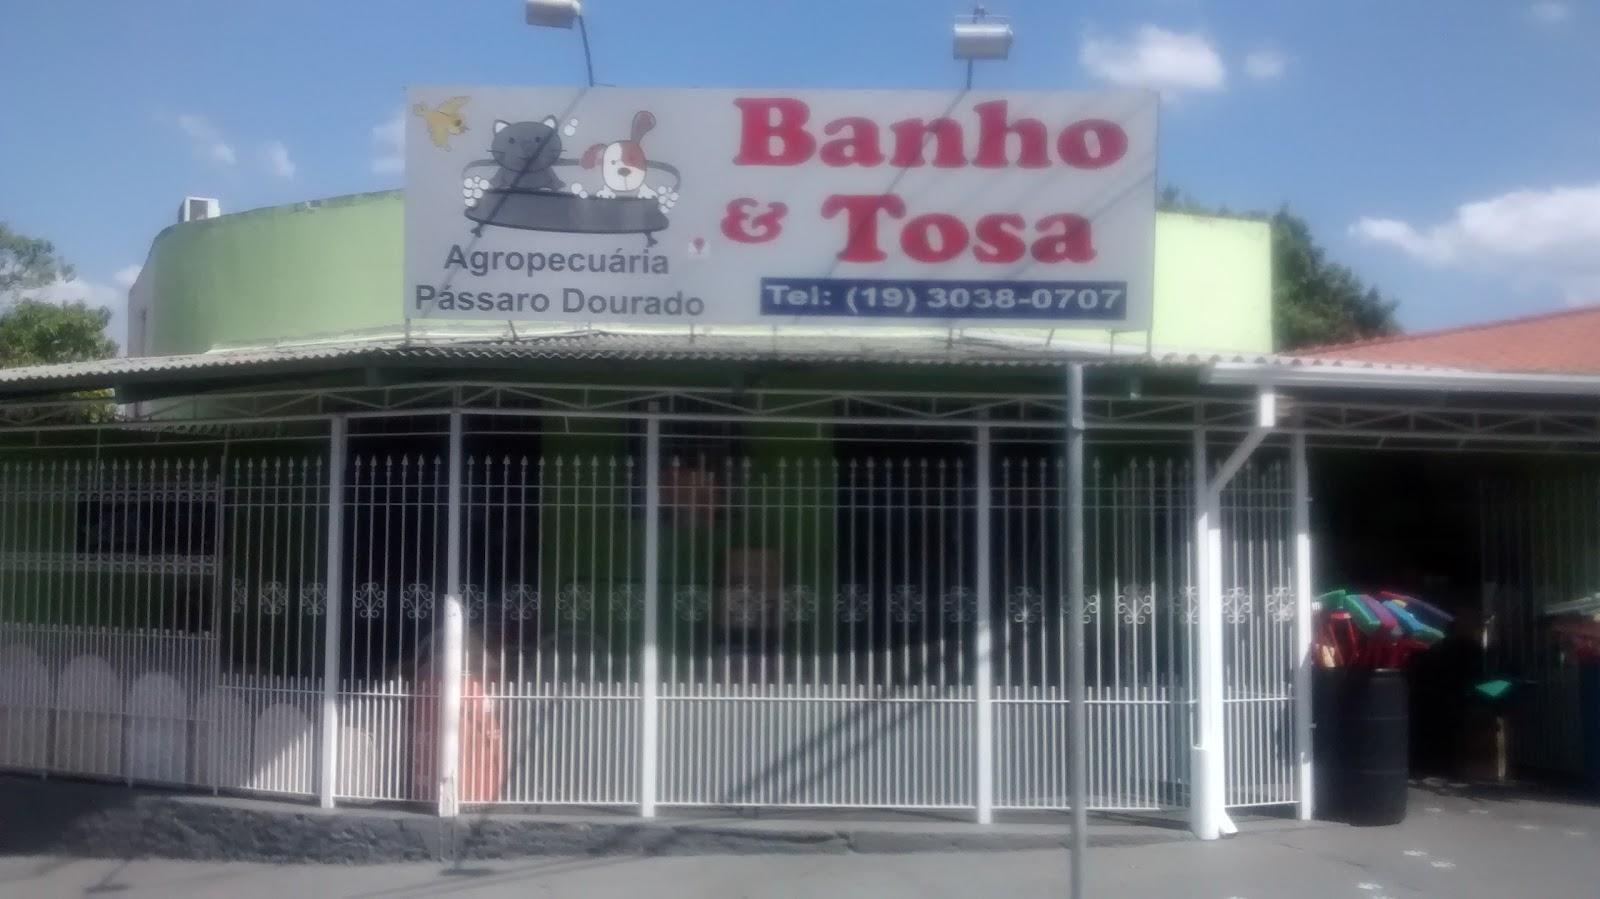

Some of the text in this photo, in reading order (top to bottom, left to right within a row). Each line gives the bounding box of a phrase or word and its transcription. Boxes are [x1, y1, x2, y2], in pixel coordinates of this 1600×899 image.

[732, 97, 1129, 170] Banho
[720, 193, 1098, 264] & Tosa
[443, 244, 669, 277] Agropecuária
[415, 284, 705, 316] Pássaro Dourado
[765, 284, 1124, 314] Tel: (19) 3038-0707
